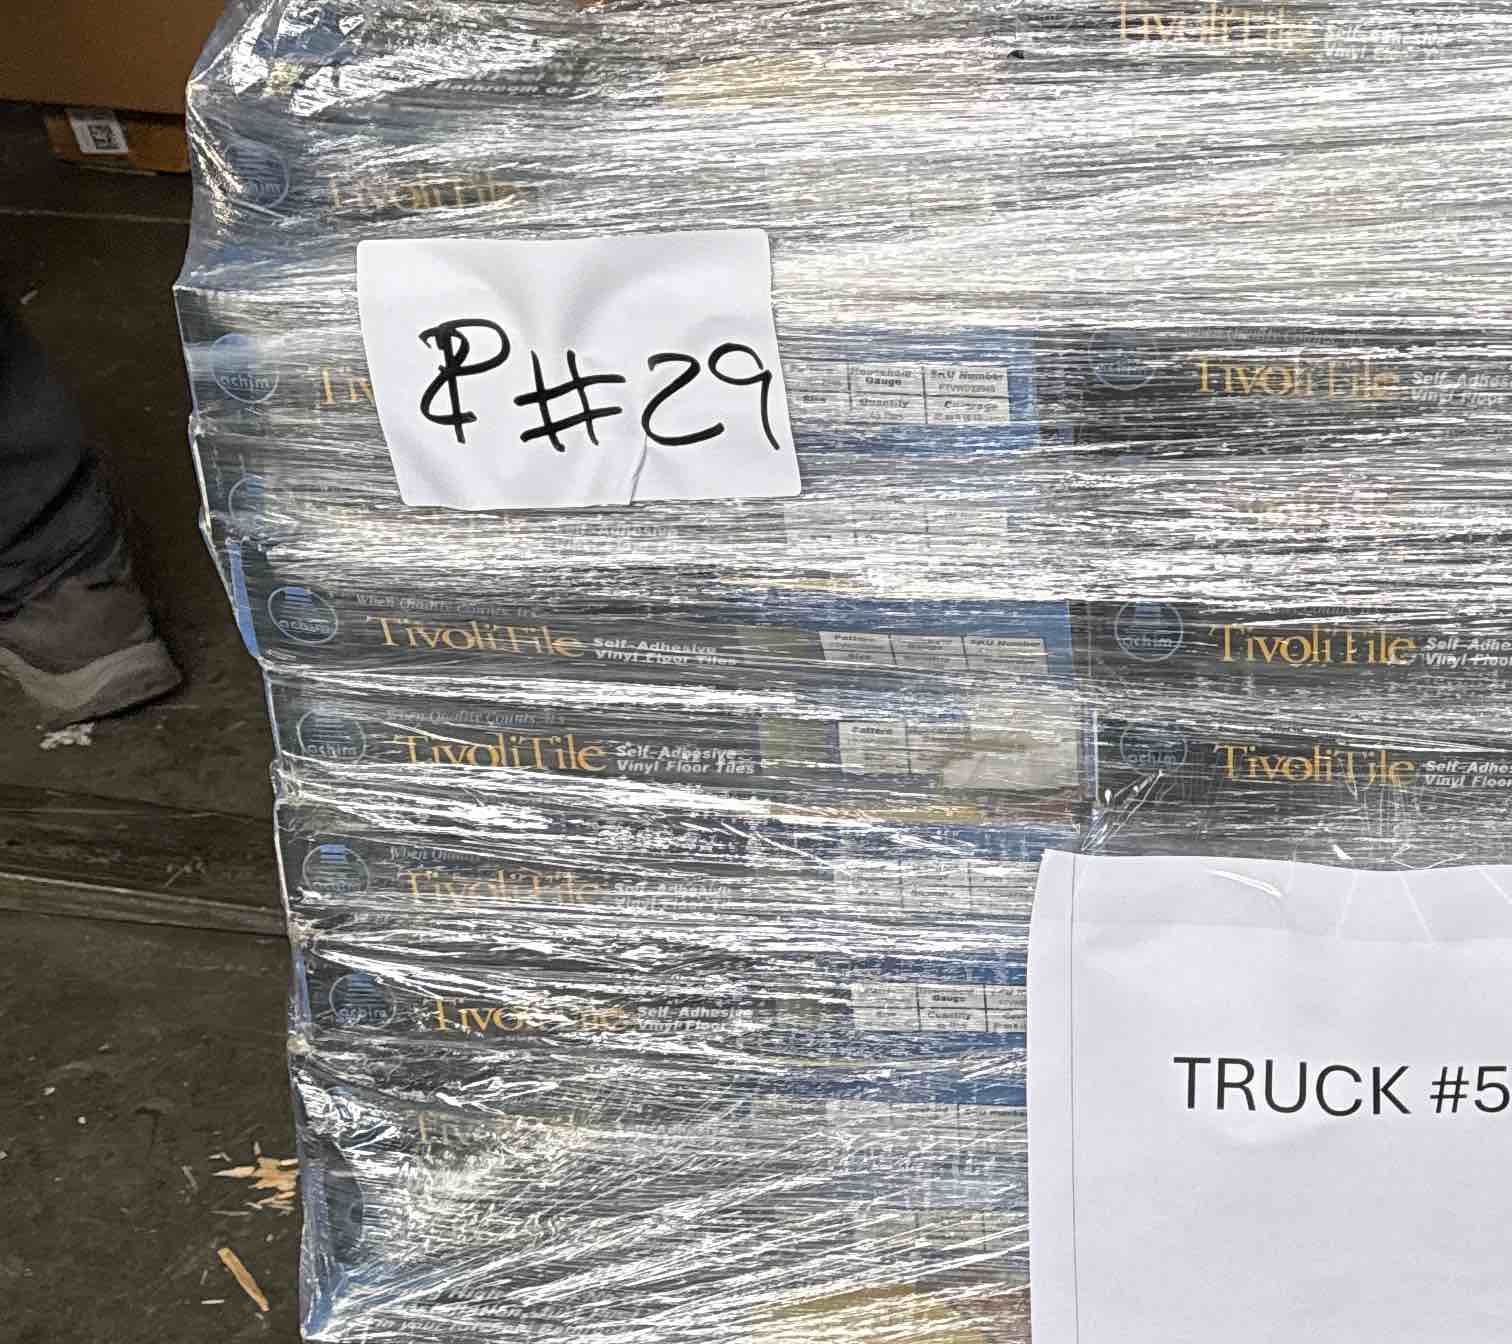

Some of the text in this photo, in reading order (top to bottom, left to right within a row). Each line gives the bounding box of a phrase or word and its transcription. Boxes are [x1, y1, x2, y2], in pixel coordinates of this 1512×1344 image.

[592, 637, 719, 657] Self-Adhesive
[616, 758, 755, 776] Vinyl Floor Tiles
[1212, 741, 1417, 787] TivoliTile
[1424, 774, 1468, 789] Vinyl
[1173, 1055, 1511, 1117] TRUCK #5
